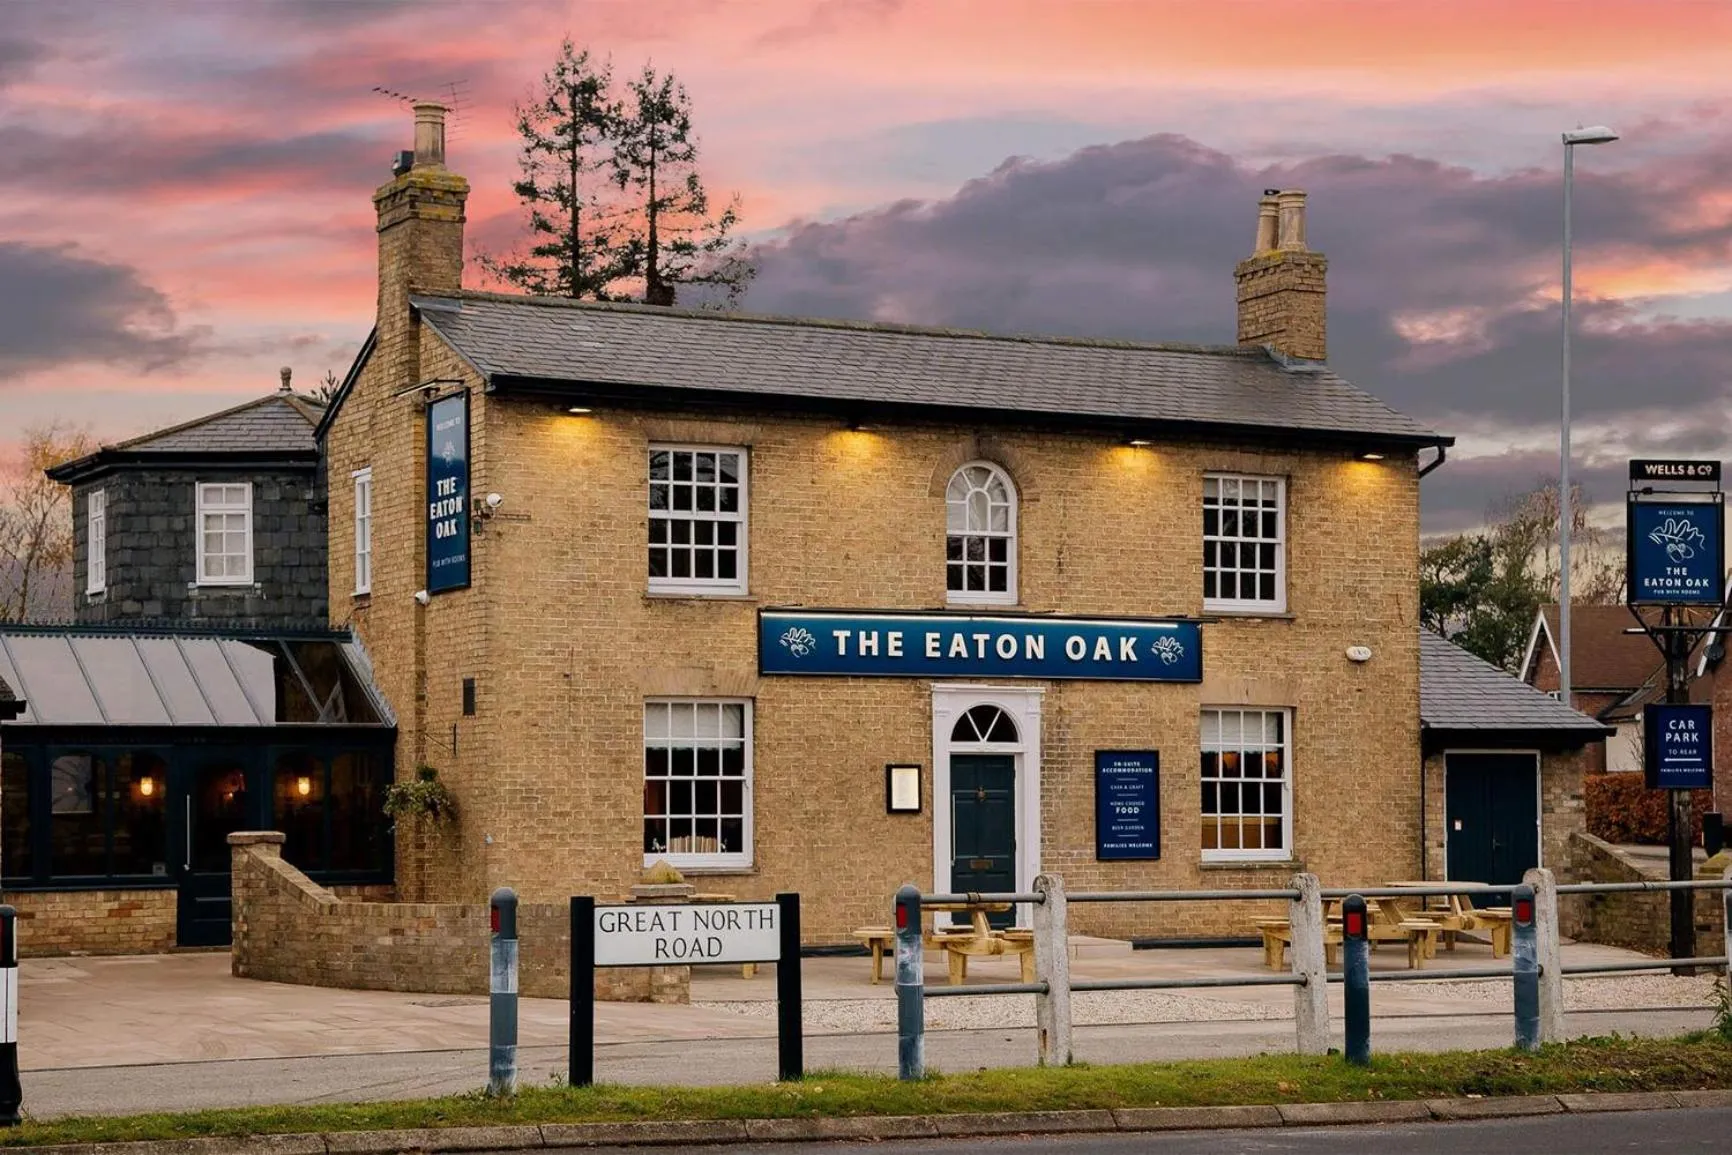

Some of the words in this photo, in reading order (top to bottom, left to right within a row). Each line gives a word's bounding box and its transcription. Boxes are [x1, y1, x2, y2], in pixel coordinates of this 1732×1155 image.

[1645, 464, 1685, 475] WELLS
[1687, 465, 1696, 475] &
[436, 476, 458, 497] THE
[430, 496, 463, 520] EATON
[436, 519, 457, 539] OAK
[1666, 567, 1688, 576] THE
[1644, 578, 1682, 587] EATON
[1686, 578, 1709, 587] OAK
[832, 630, 904, 656] THE
[925, 632, 1045, 660] EATON
[1065, 635, 1138, 662] OAK
[1669, 719, 1695, 730] CAR
[1665, 732, 1699, 742] PARK
[1115, 806, 1140, 814] FOOD
[599, 911, 682, 933] GREAT
[693, 909, 775, 931] NORTH
[655, 936, 723, 959] ROAD
